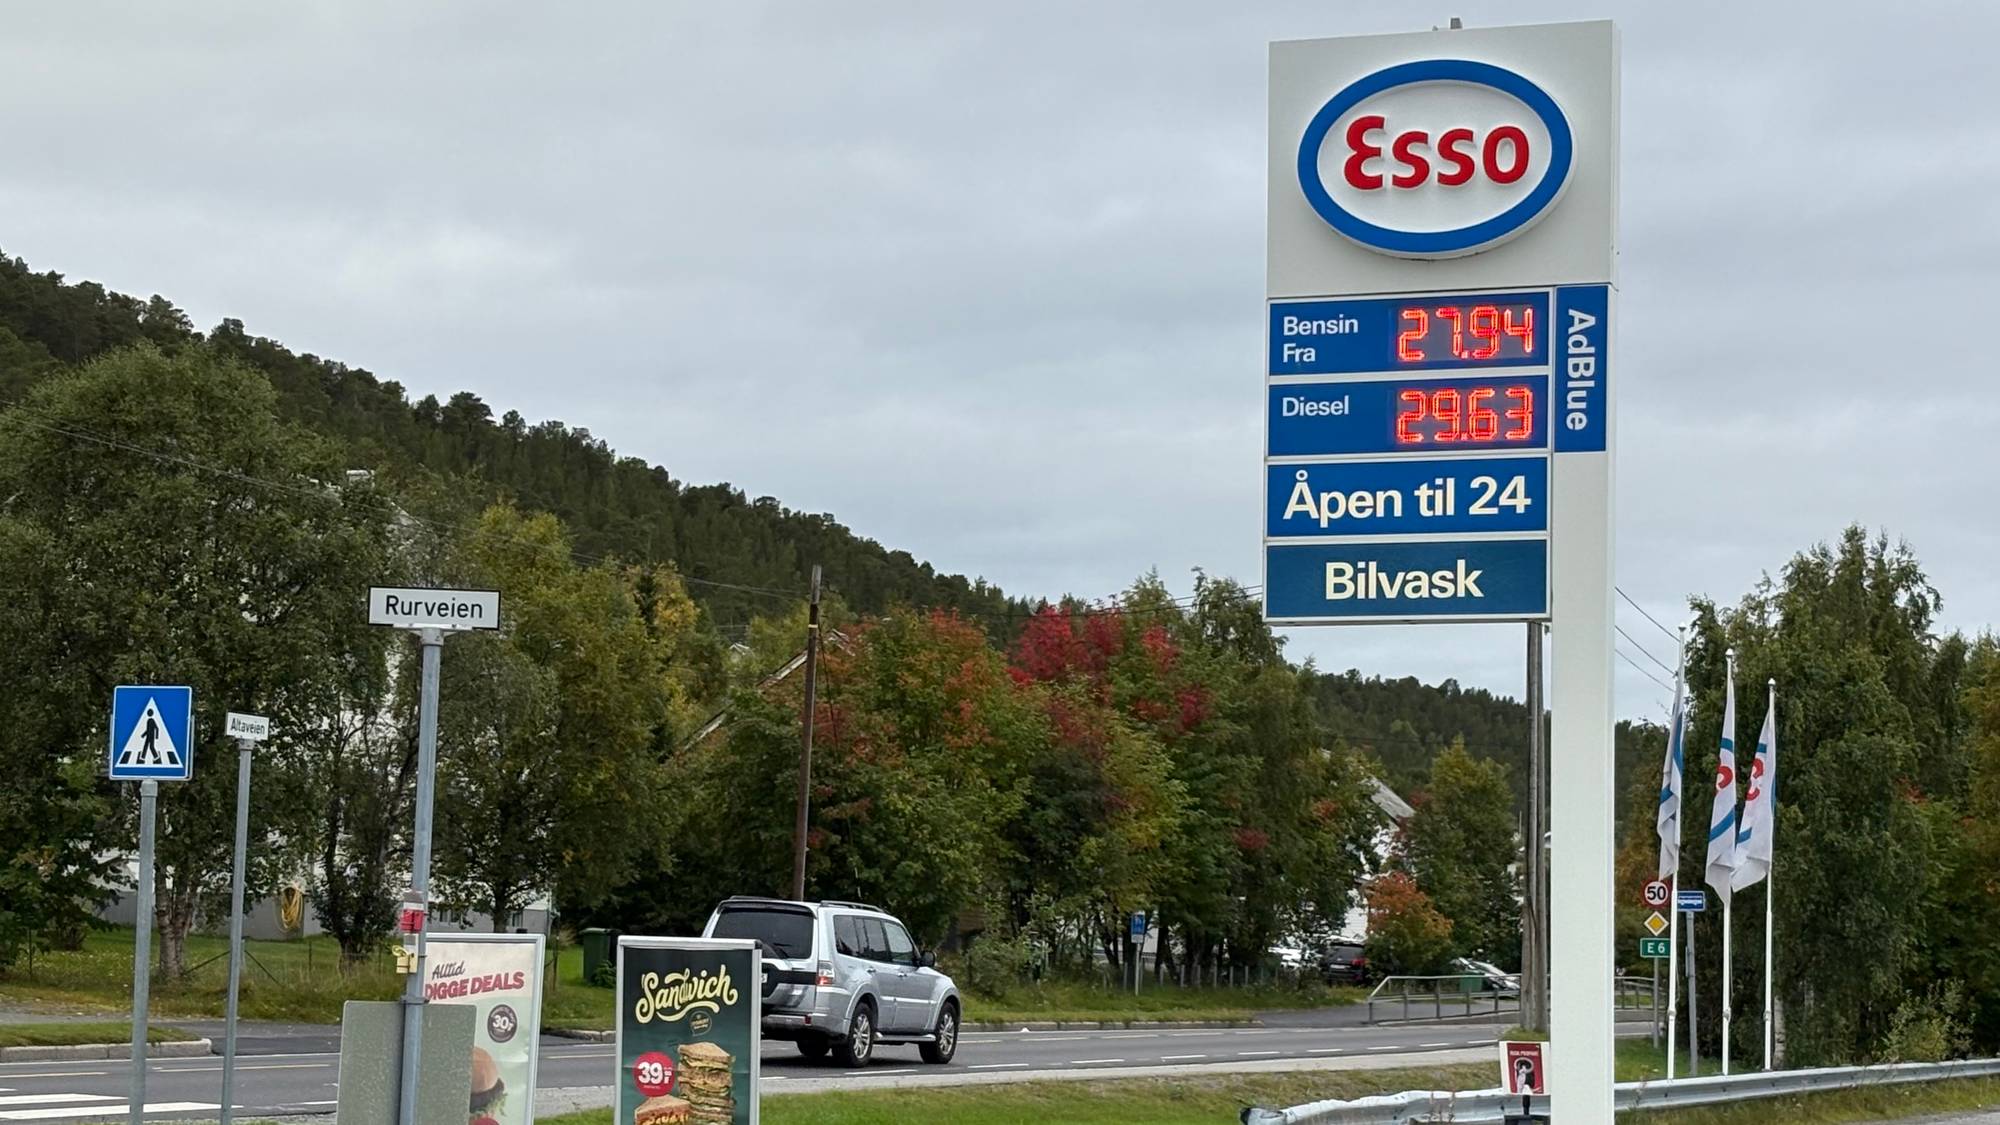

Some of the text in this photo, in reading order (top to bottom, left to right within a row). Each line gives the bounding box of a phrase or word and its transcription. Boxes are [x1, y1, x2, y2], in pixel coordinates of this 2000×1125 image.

[1343, 115, 1530, 191] Esso
[1283, 314, 1359, 336] Bensin
[1399, 306, 1534, 362] 27.94
[1283, 343, 1316, 363] Fra
[1566, 308, 1596, 431] AdBlue
[1282, 395, 1349, 417] Diesel
[1398, 386, 1534, 443] 29.63
[1283, 470, 1532, 528] Åpen til 24
[1325, 559, 1484, 600] Bilvask
[385, 594, 483, 619] Rurveien
[231, 717, 266, 735] Altaveien
[1646, 885, 1667, 901] 50
[1647, 942, 1665, 954] E 6
[432, 961, 466, 980] Alltid
[424, 971, 525, 1001] DIGGE DEALS
[635, 964, 739, 1024] Sandwich
